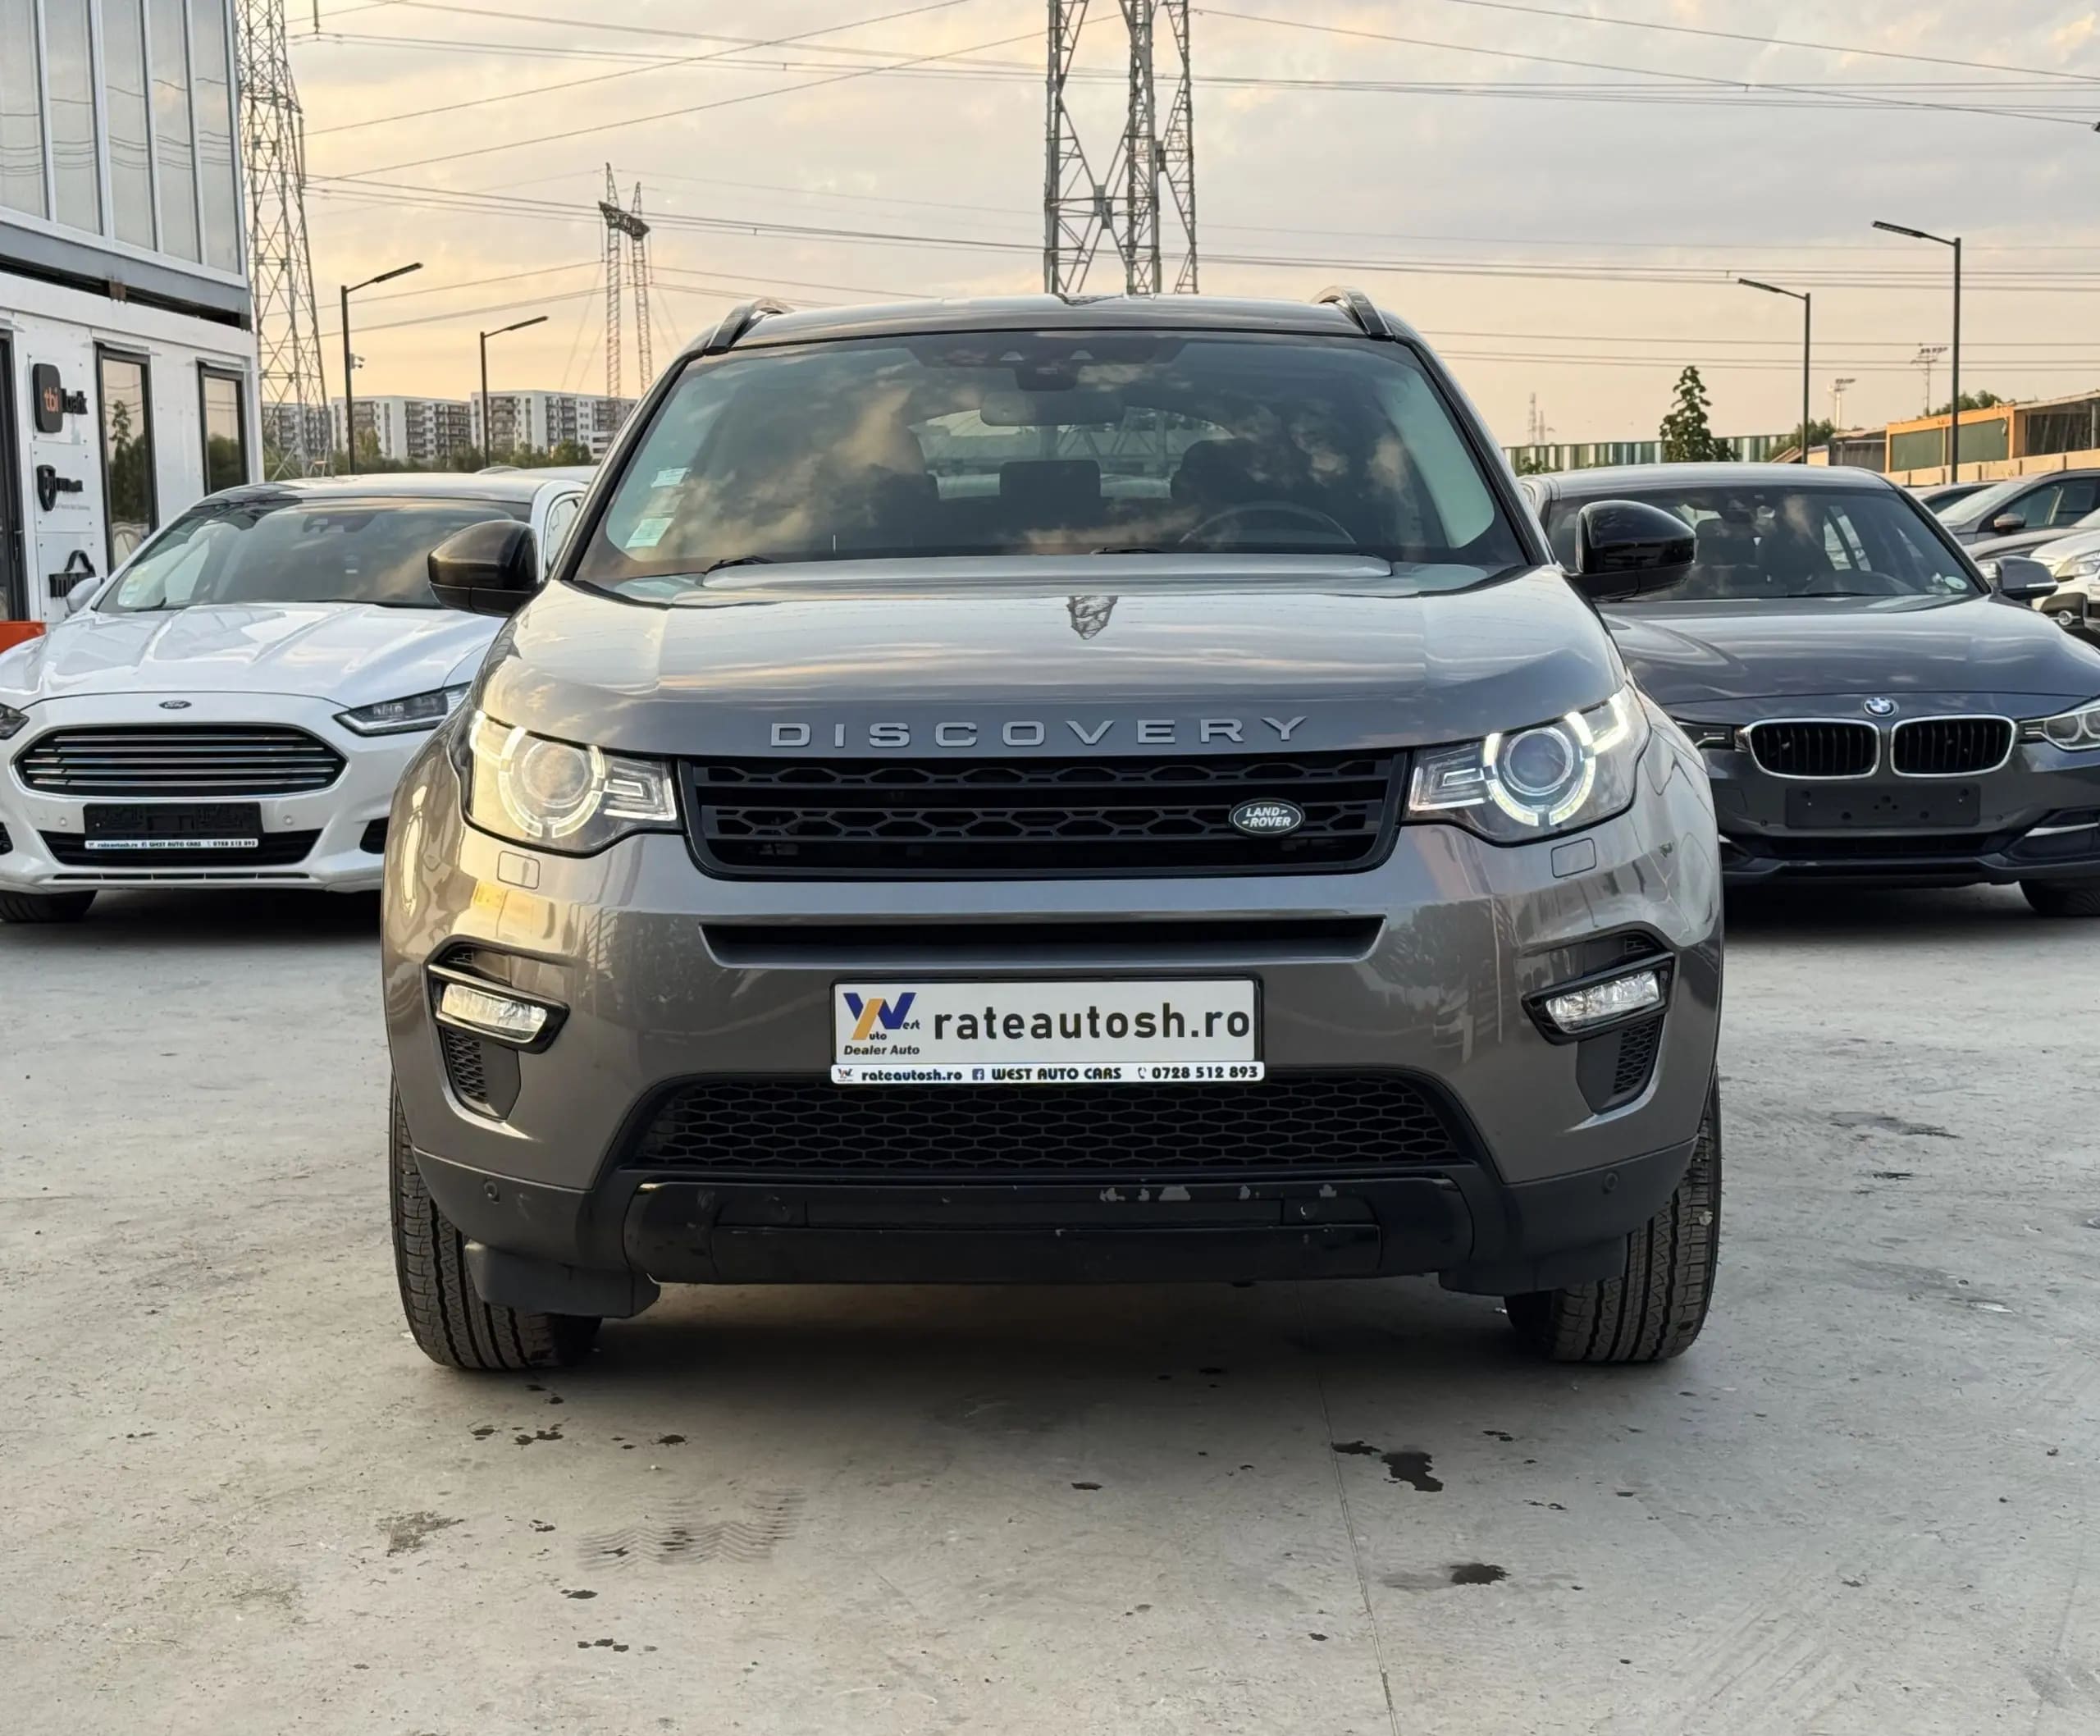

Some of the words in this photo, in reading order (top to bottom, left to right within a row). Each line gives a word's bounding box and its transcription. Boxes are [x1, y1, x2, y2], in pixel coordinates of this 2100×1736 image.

[43, 386, 59, 413] tbi
[770, 715, 1307, 749] DISCOVERY
[934, 1003, 1250, 1040] rateautosh.ro
[843, 1044, 888, 1056] Dealer
[889, 1044, 920, 1056] Auto
[861, 1068, 963, 1081] rateautosh.ro
[991, 1068, 1033, 1080] WEST
[1037, 1067, 1080, 1080] AUTO
[1084, 1067, 1122, 1080] CARS
[1151, 1066, 1191, 1080] 0728
[1195, 1067, 1225, 1079] 512
[1229, 1066, 1258, 1079] 893
